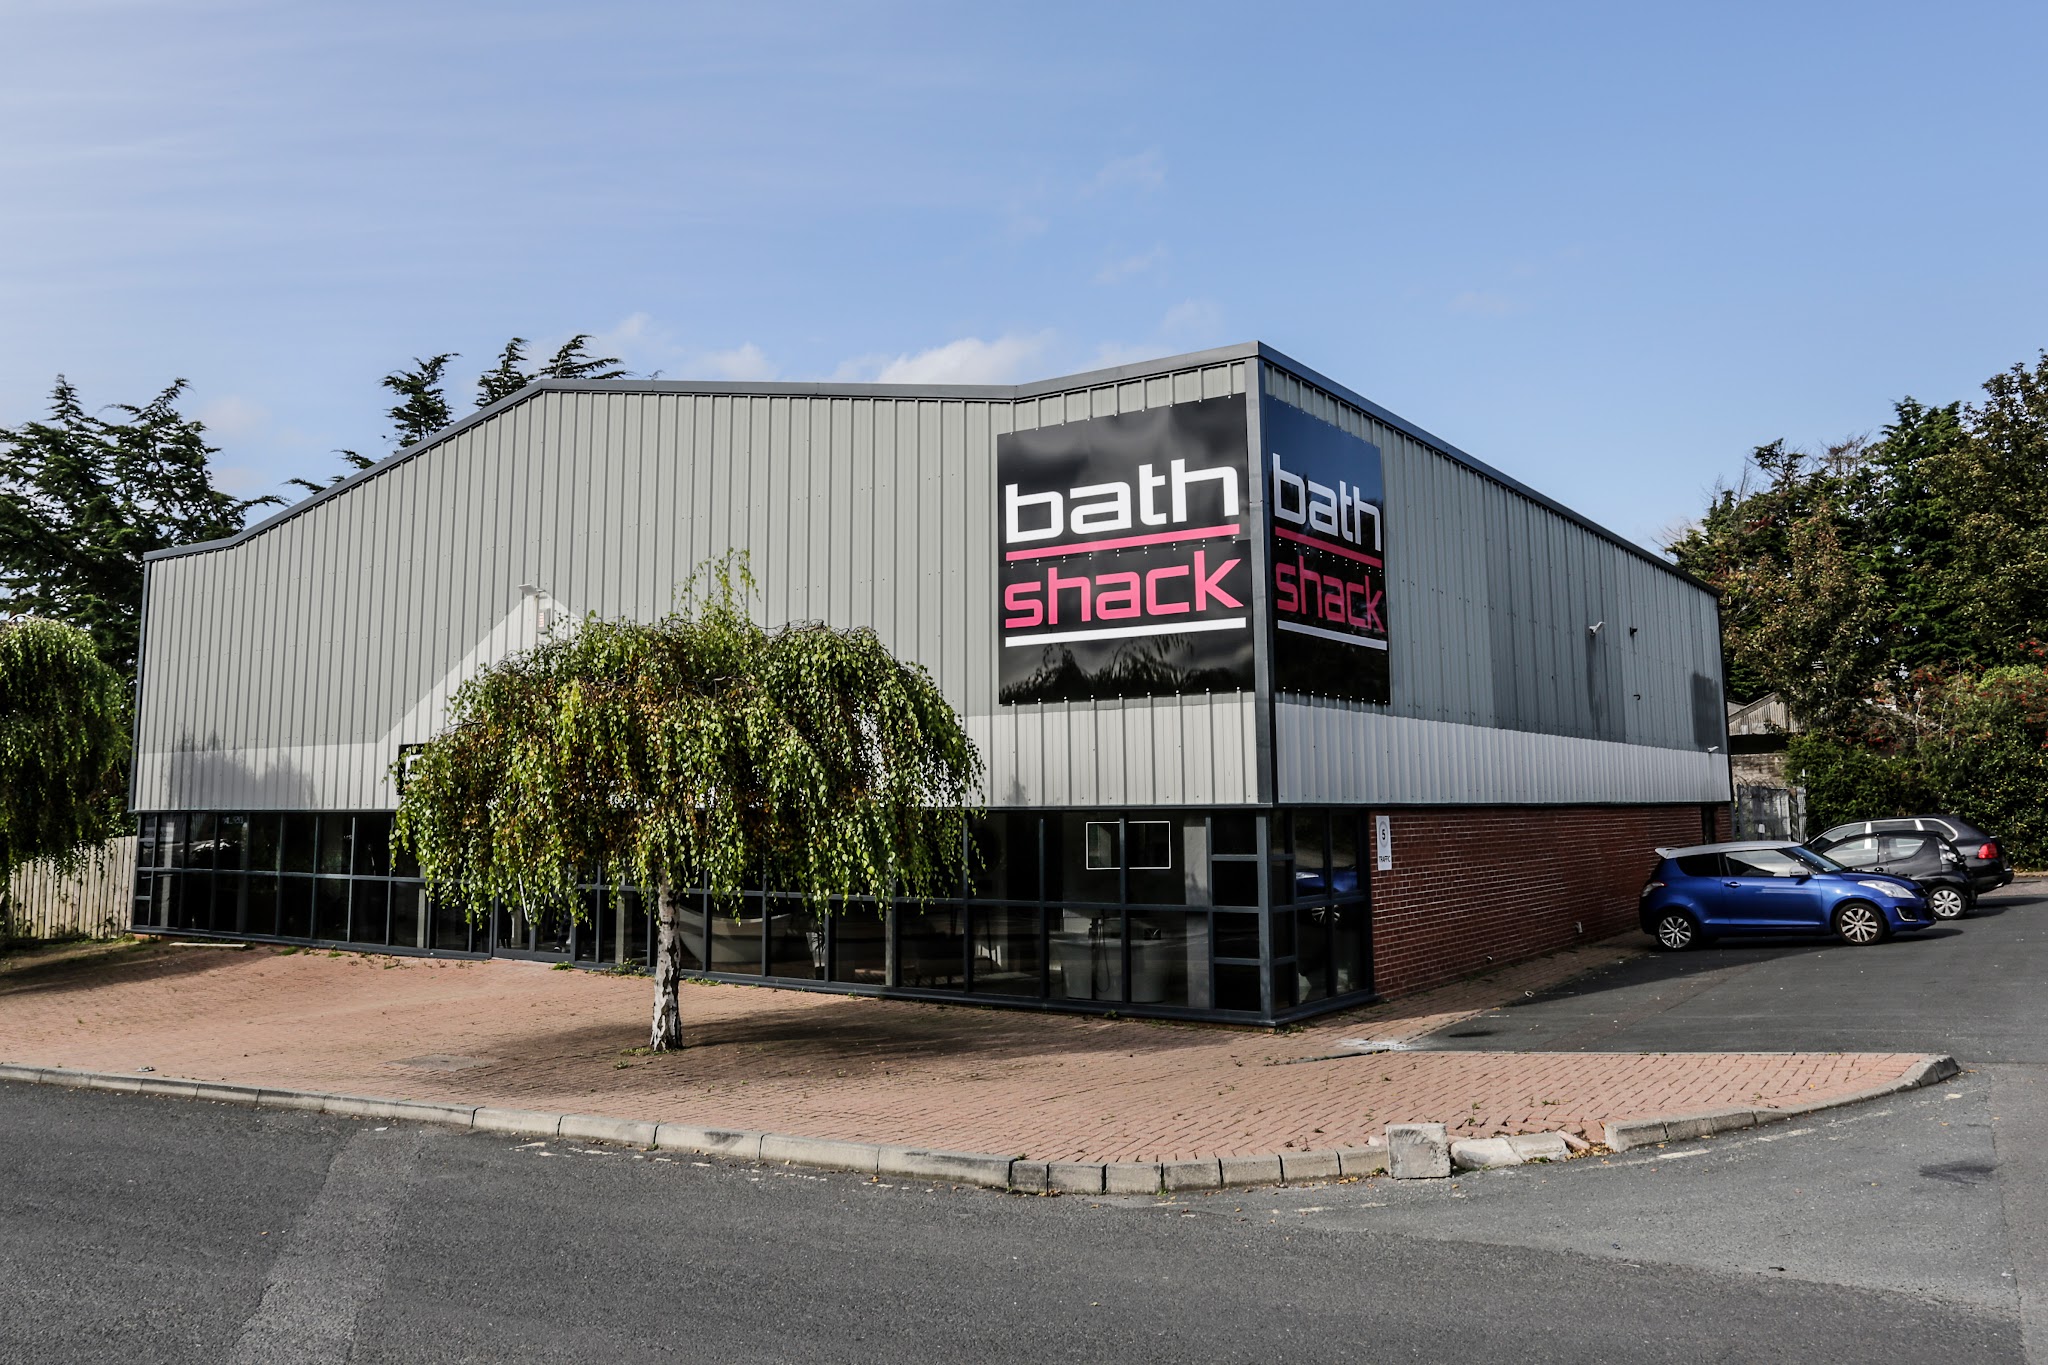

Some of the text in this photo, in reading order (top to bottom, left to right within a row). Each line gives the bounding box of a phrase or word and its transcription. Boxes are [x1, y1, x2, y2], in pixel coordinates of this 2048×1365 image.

[1005, 458, 1240, 544] bath
[1272, 453, 1382, 552] bath
[1004, 551, 1244, 629] shack
[1275, 555, 1385, 633] shack
[1379, 855, 1391, 863] TRAFFIC
[1381, 829, 1386, 840] 5
